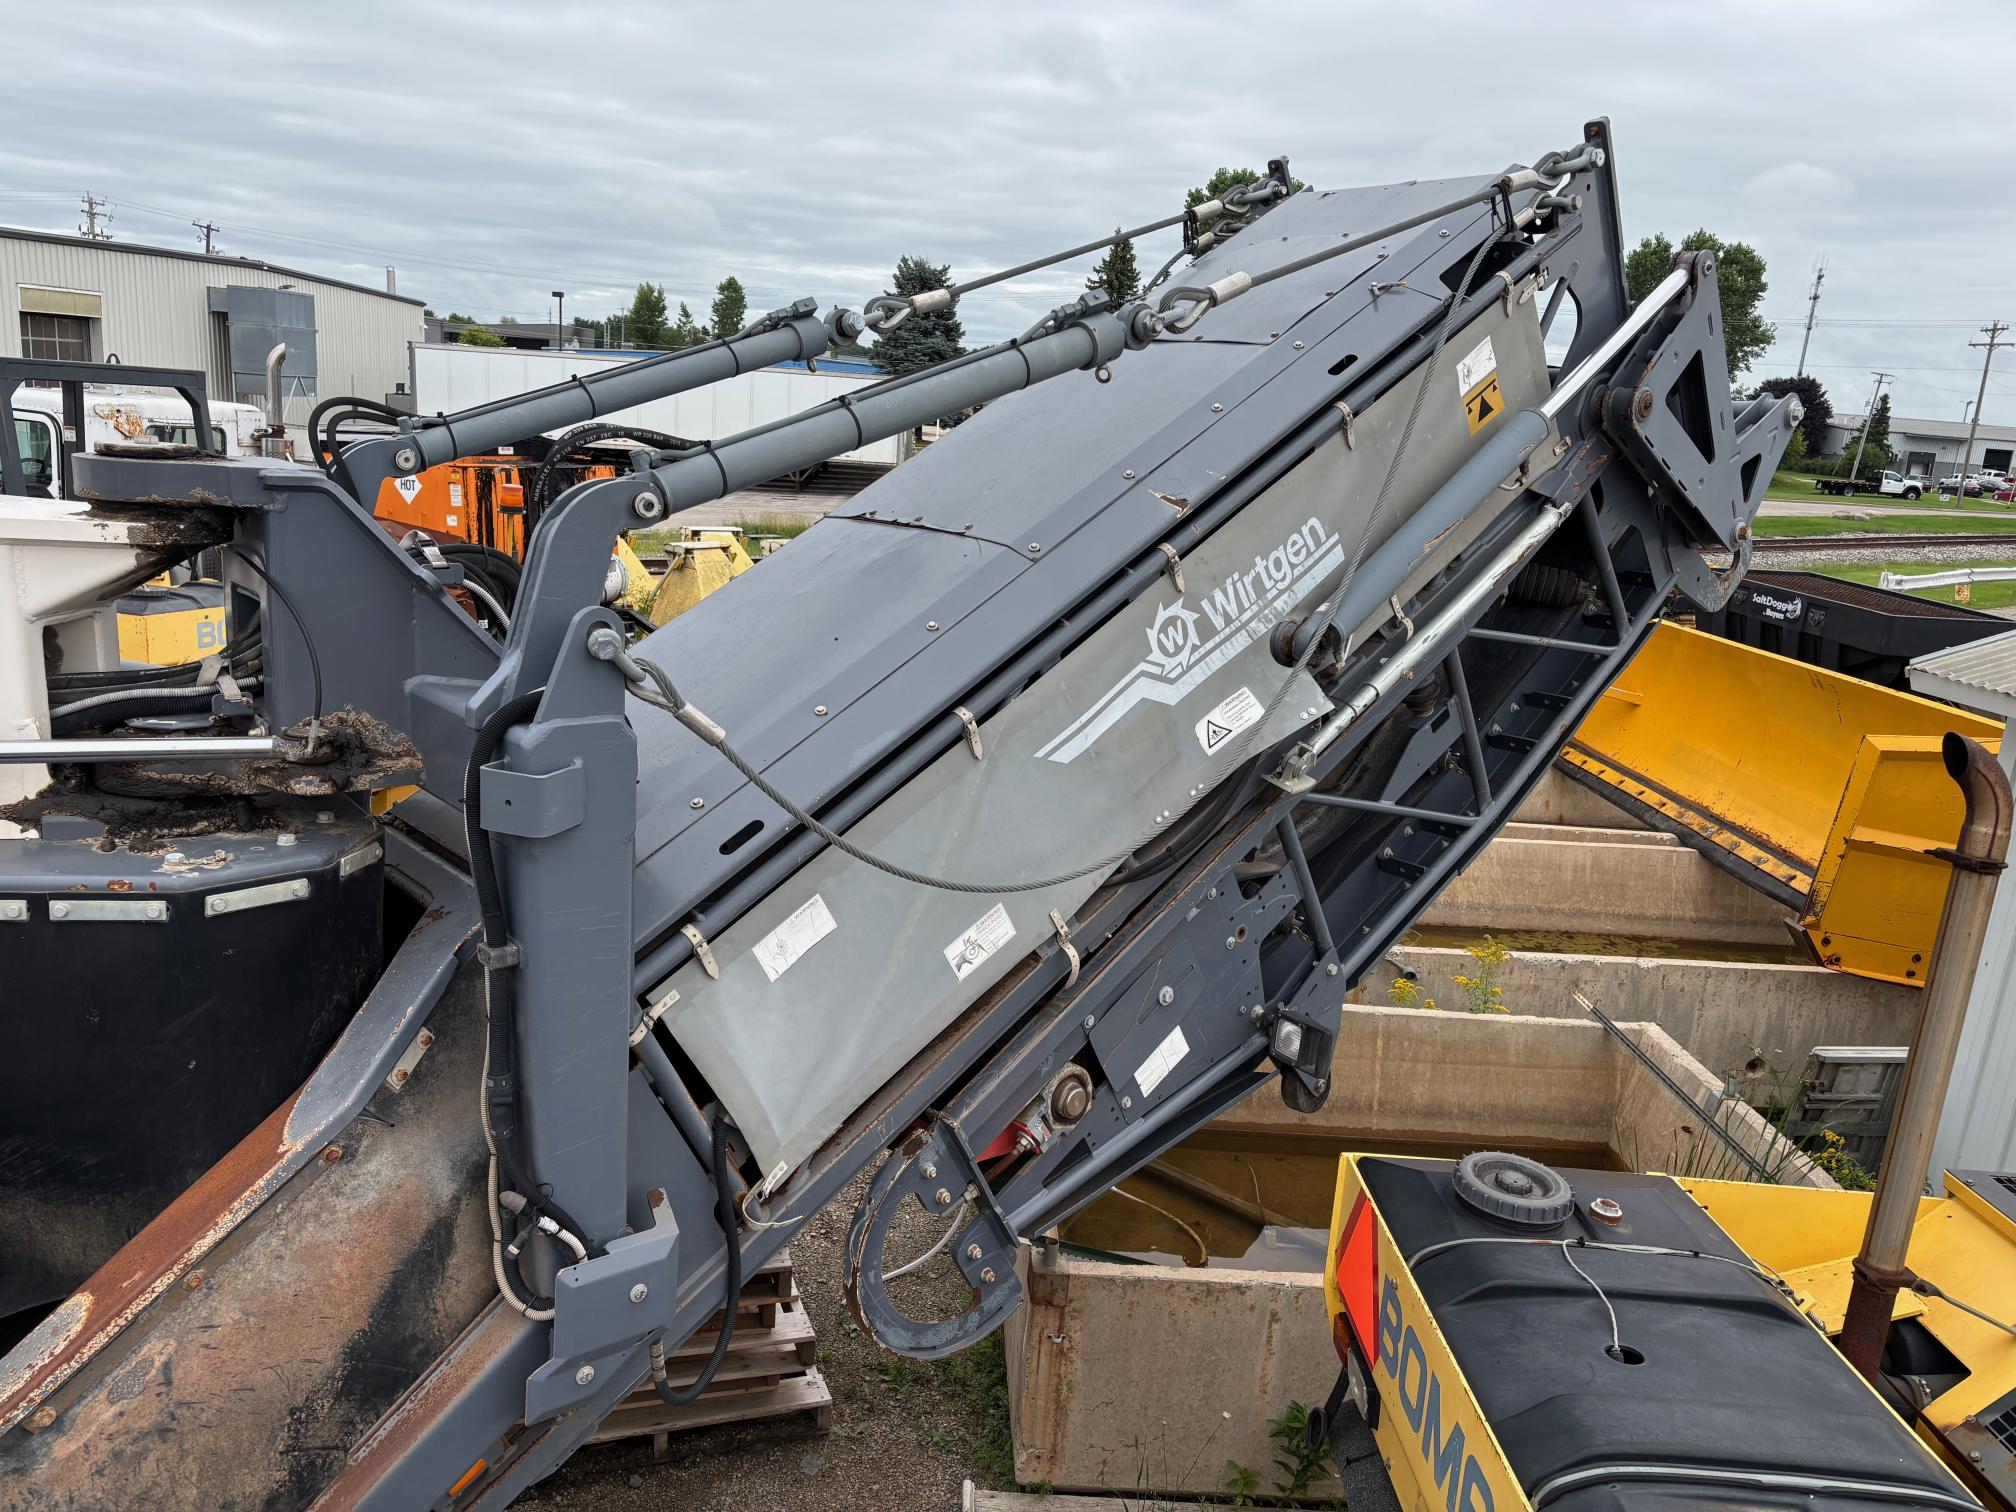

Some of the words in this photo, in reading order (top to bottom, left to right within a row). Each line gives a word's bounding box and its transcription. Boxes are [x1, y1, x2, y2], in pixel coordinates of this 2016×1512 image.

[400, 479, 416, 491] HOT
[533, 464, 552, 501] HANSA-FLEX
[1200, 516, 1327, 631] Wirtgen
[1752, 593, 1788, 611] SaltDogg
[1223, 689, 1247, 707] WARNING
[793, 898, 819, 919] WARNING
[979, 906, 1001, 926] WARNING
